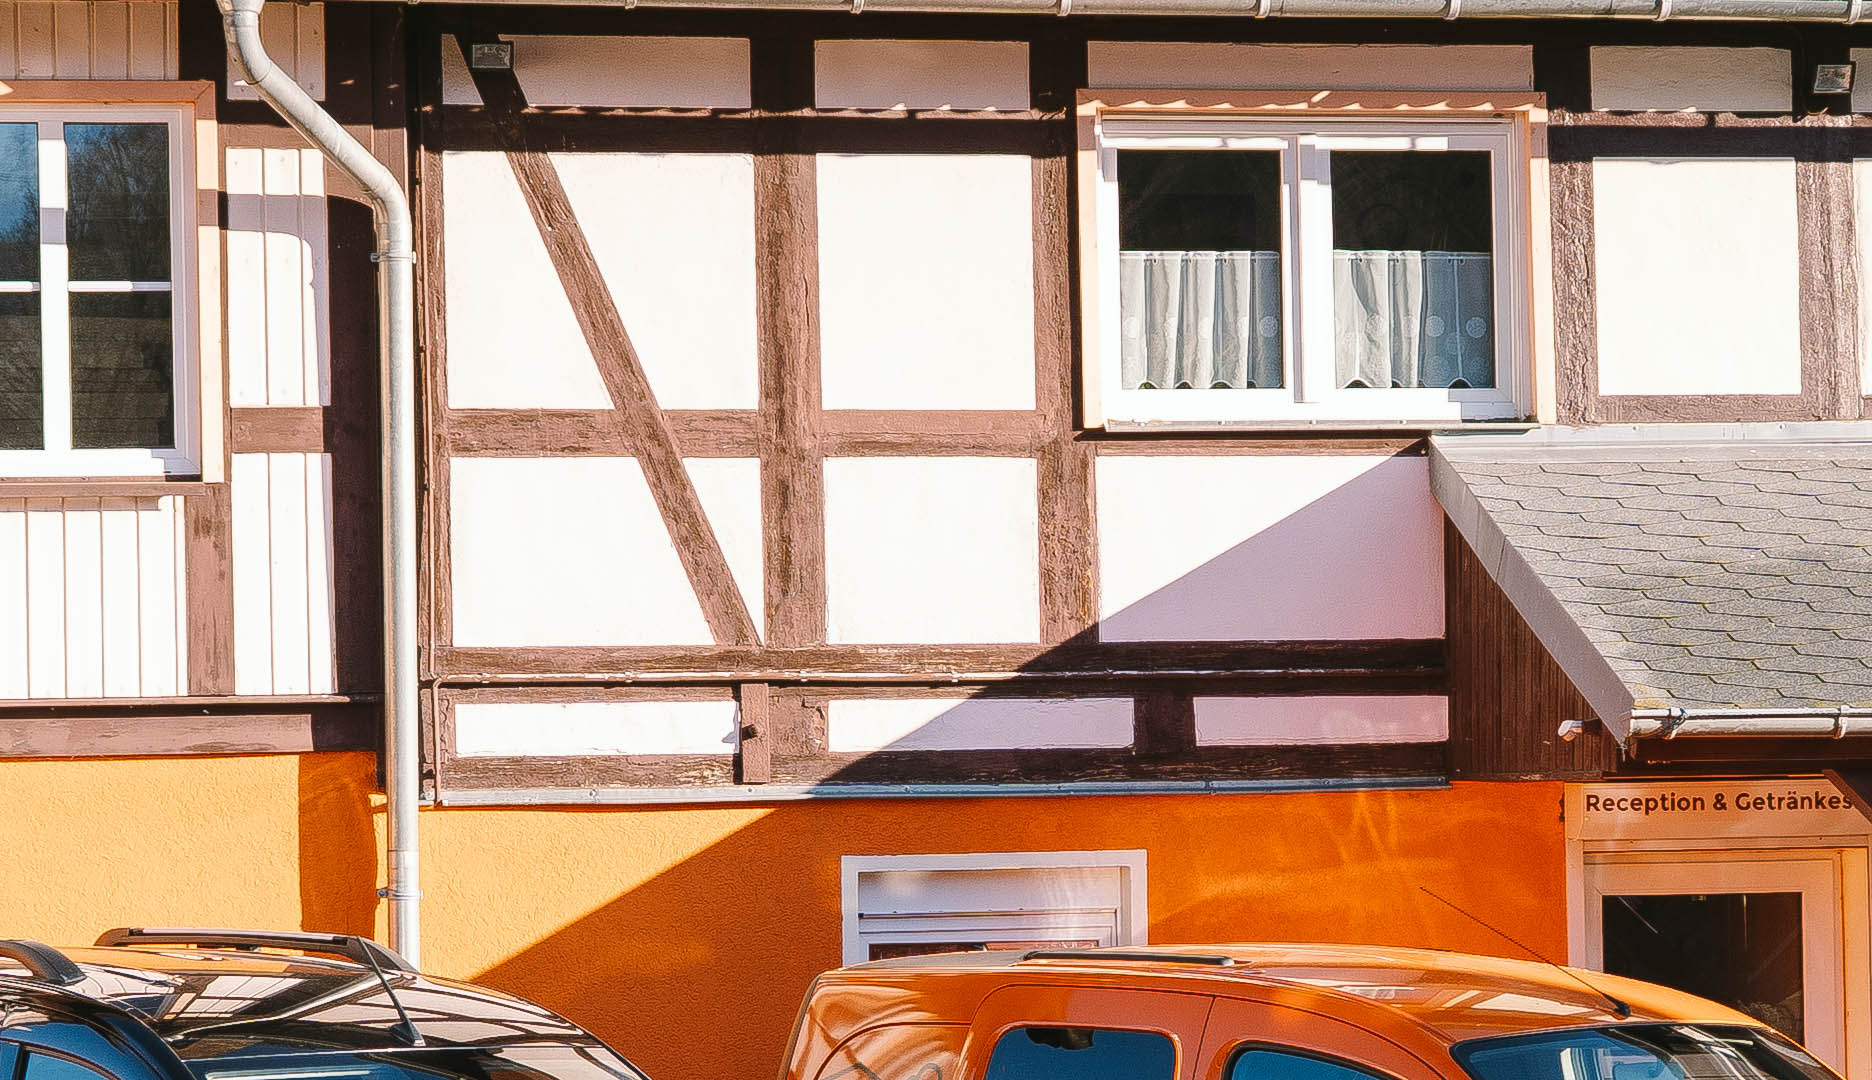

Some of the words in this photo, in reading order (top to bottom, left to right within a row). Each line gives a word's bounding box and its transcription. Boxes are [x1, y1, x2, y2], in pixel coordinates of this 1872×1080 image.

[1585, 792, 1706, 815] Reception
[1712, 793, 1728, 811] &
[1734, 790, 1854, 811] Getränkes
